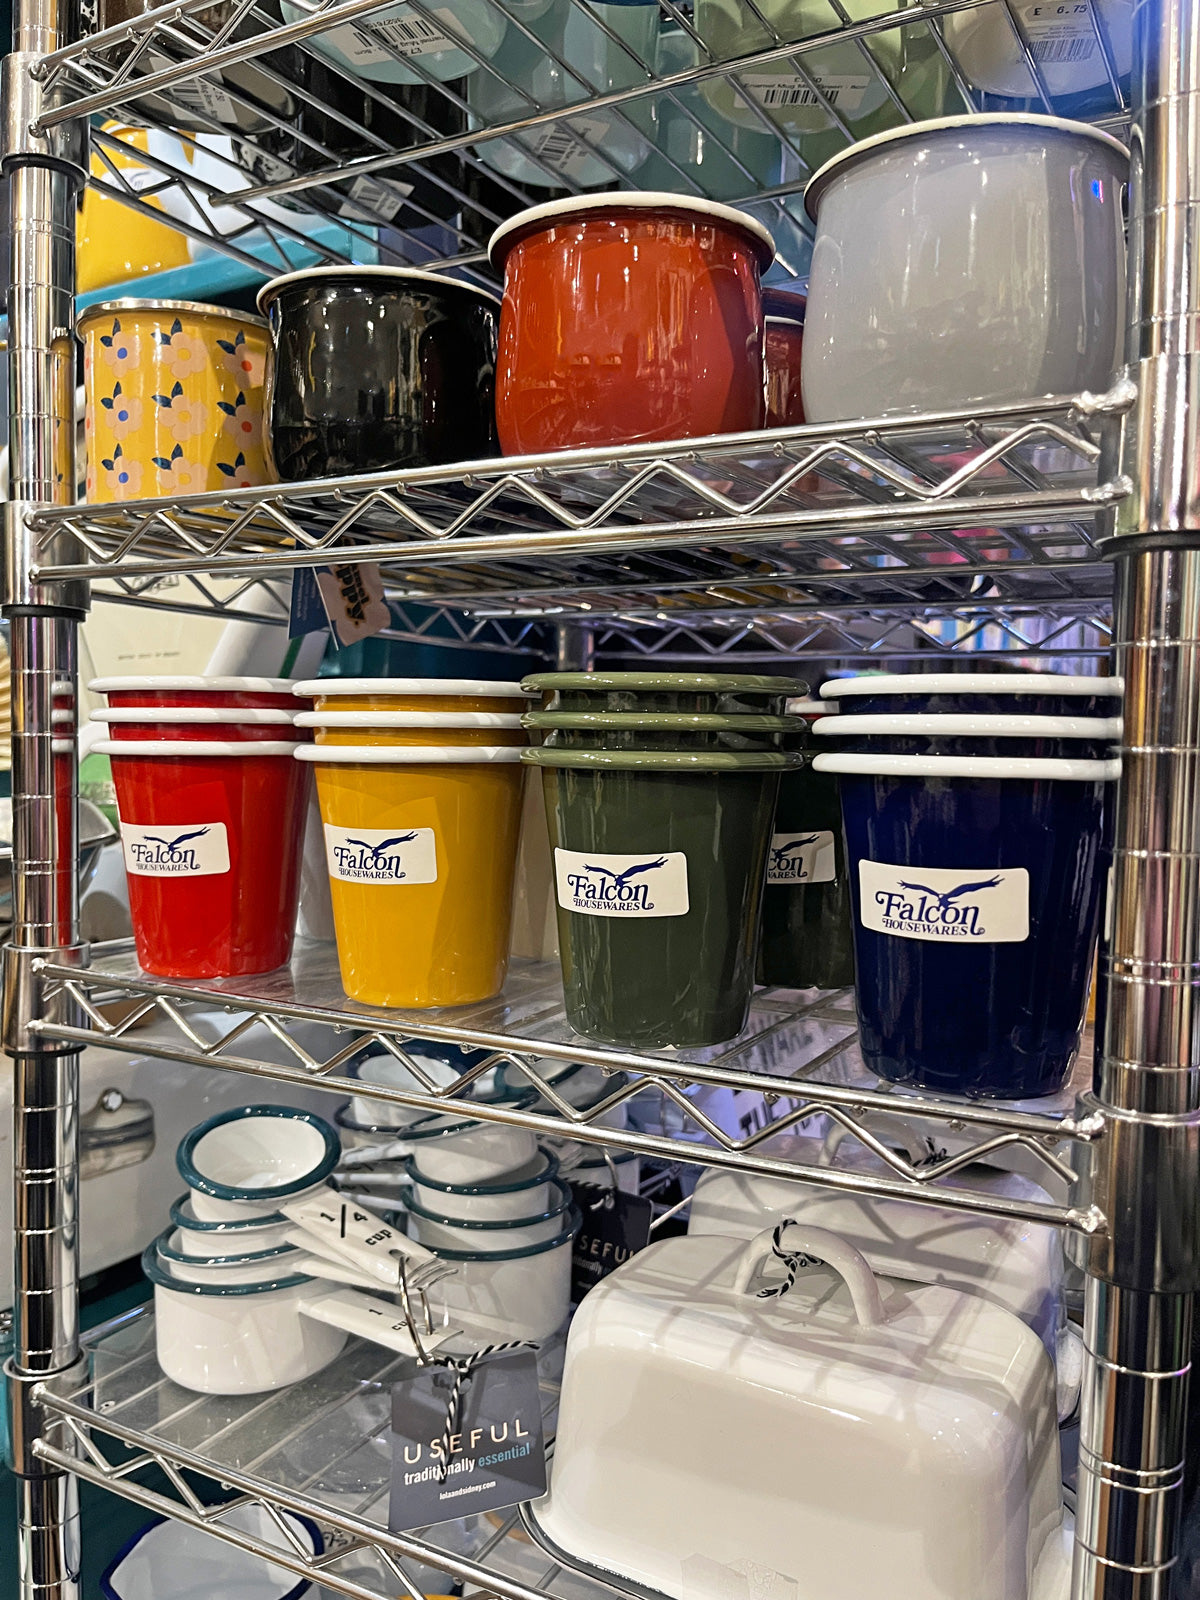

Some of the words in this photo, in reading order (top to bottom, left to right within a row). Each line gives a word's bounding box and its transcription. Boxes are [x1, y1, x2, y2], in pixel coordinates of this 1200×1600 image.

[1033, 7, 1043, 16] £
[1056, 4, 1088, 15] 6.75
[420, 36, 449, 45] namel
[131, 842, 201, 871] Falcon
[135, 862, 190, 873] HOUSEWARES
[333, 846, 406, 879] Falcon
[768, 855, 808, 879] con
[338, 866, 394, 880] HOUSEWARES
[567, 873, 655, 911] Falcon
[572, 897, 641, 912] HOUSEWARES
[875, 891, 986, 936] Falcon
[882, 918, 969, 937] HOUSEWARES
[320, 1204, 369, 1238] 1/4
[365, 1228, 393, 1246] cup
[578, 1234, 635, 1264] SEFU
[403, 1418, 529, 1465] USEFUL
[478, 1442, 531, 1468] essential
[439, 1480, 497, 1501] lolaandsidney.com
